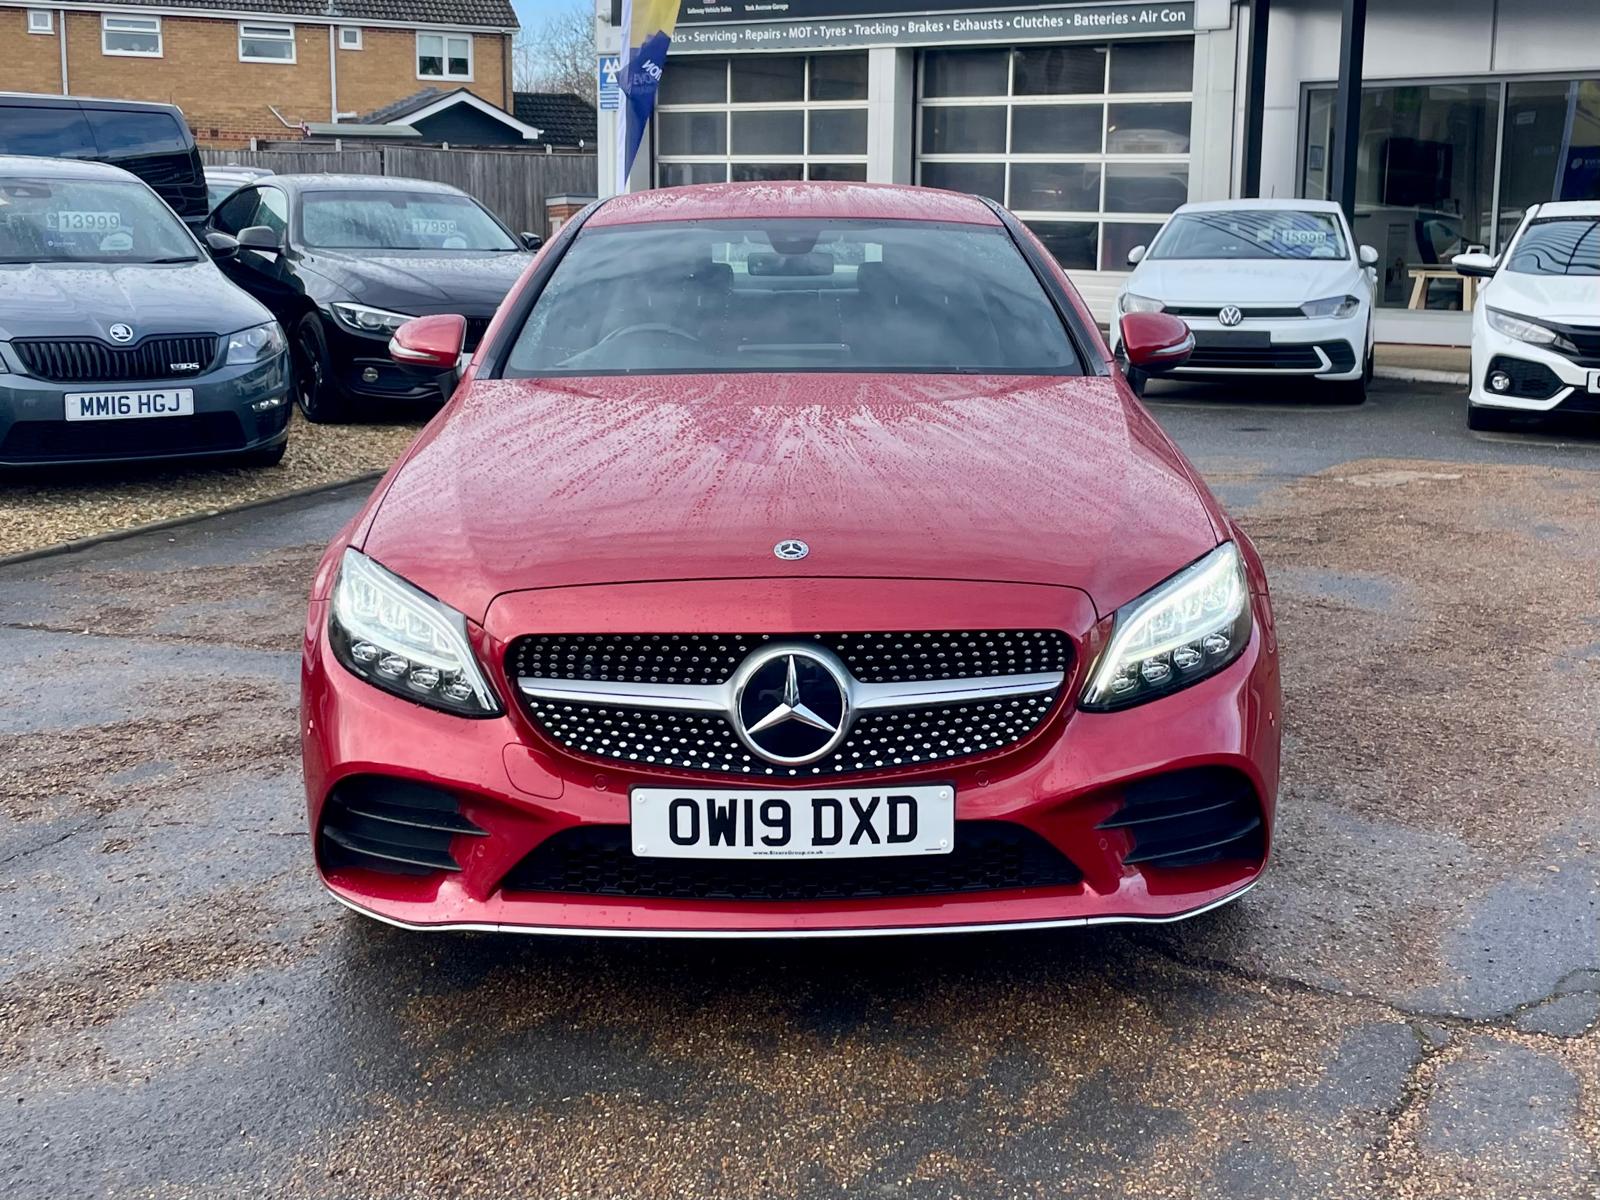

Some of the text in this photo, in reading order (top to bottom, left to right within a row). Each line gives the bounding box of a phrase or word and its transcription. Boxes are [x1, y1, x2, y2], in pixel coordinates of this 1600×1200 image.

[694, 29, 738, 43] Servicing
[745, 28, 781, 42] Repairs
[788, 27, 811, 39] MOT
[819, 25, 846, 39] Tyres
[854, 23, 899, 37] Tracking
[907, 20, 944, 33] Brakes
[953, 18, 1004, 32] Exhausts
[1013, 15, 1064, 29] Clutches
[1073, 12, 1129, 26] Batteries
[1138, 10, 1160, 24] Air
[1160, 9, 1186, 23] Con
[80, 393, 180, 416] MM16 HGJ
[669, 795, 918, 847] OW19 DXD
